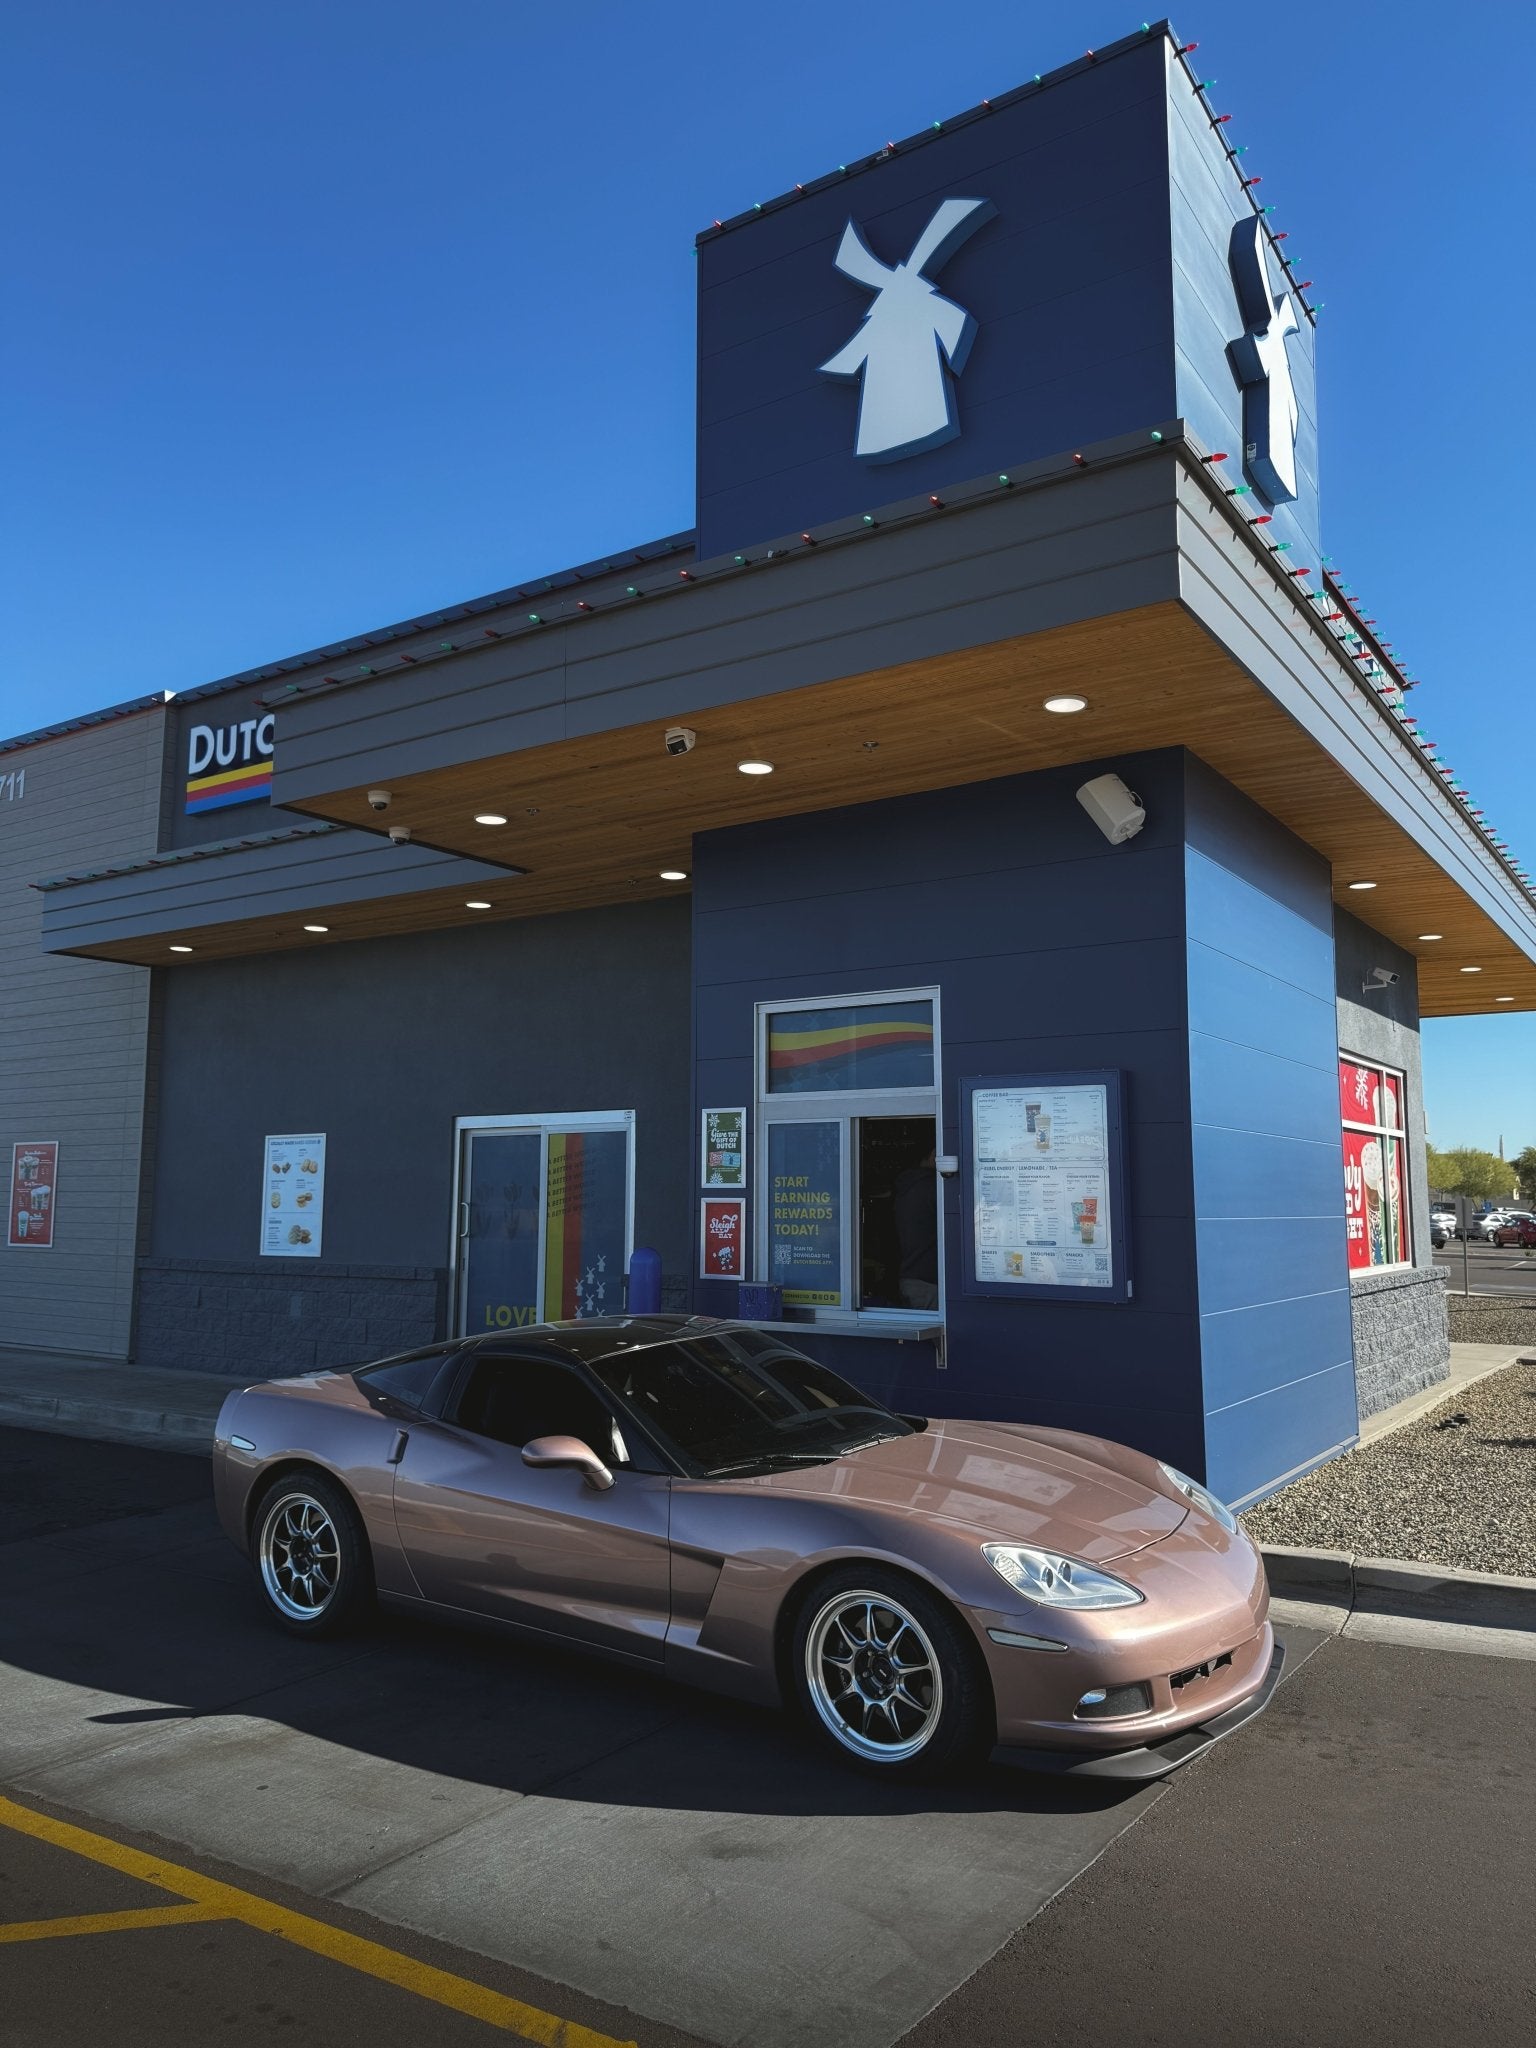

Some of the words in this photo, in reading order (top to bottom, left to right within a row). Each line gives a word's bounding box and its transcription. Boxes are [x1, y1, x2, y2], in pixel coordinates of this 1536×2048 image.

[774, 1176, 809, 1188] START
[774, 1192, 831, 1204] EARNING
[774, 1208, 833, 1220] REWARDS
[709, 1214, 739, 1233] Sleigh
[774, 1224, 819, 1236] TODAY!
[485, 1304, 537, 1327] LOVE
